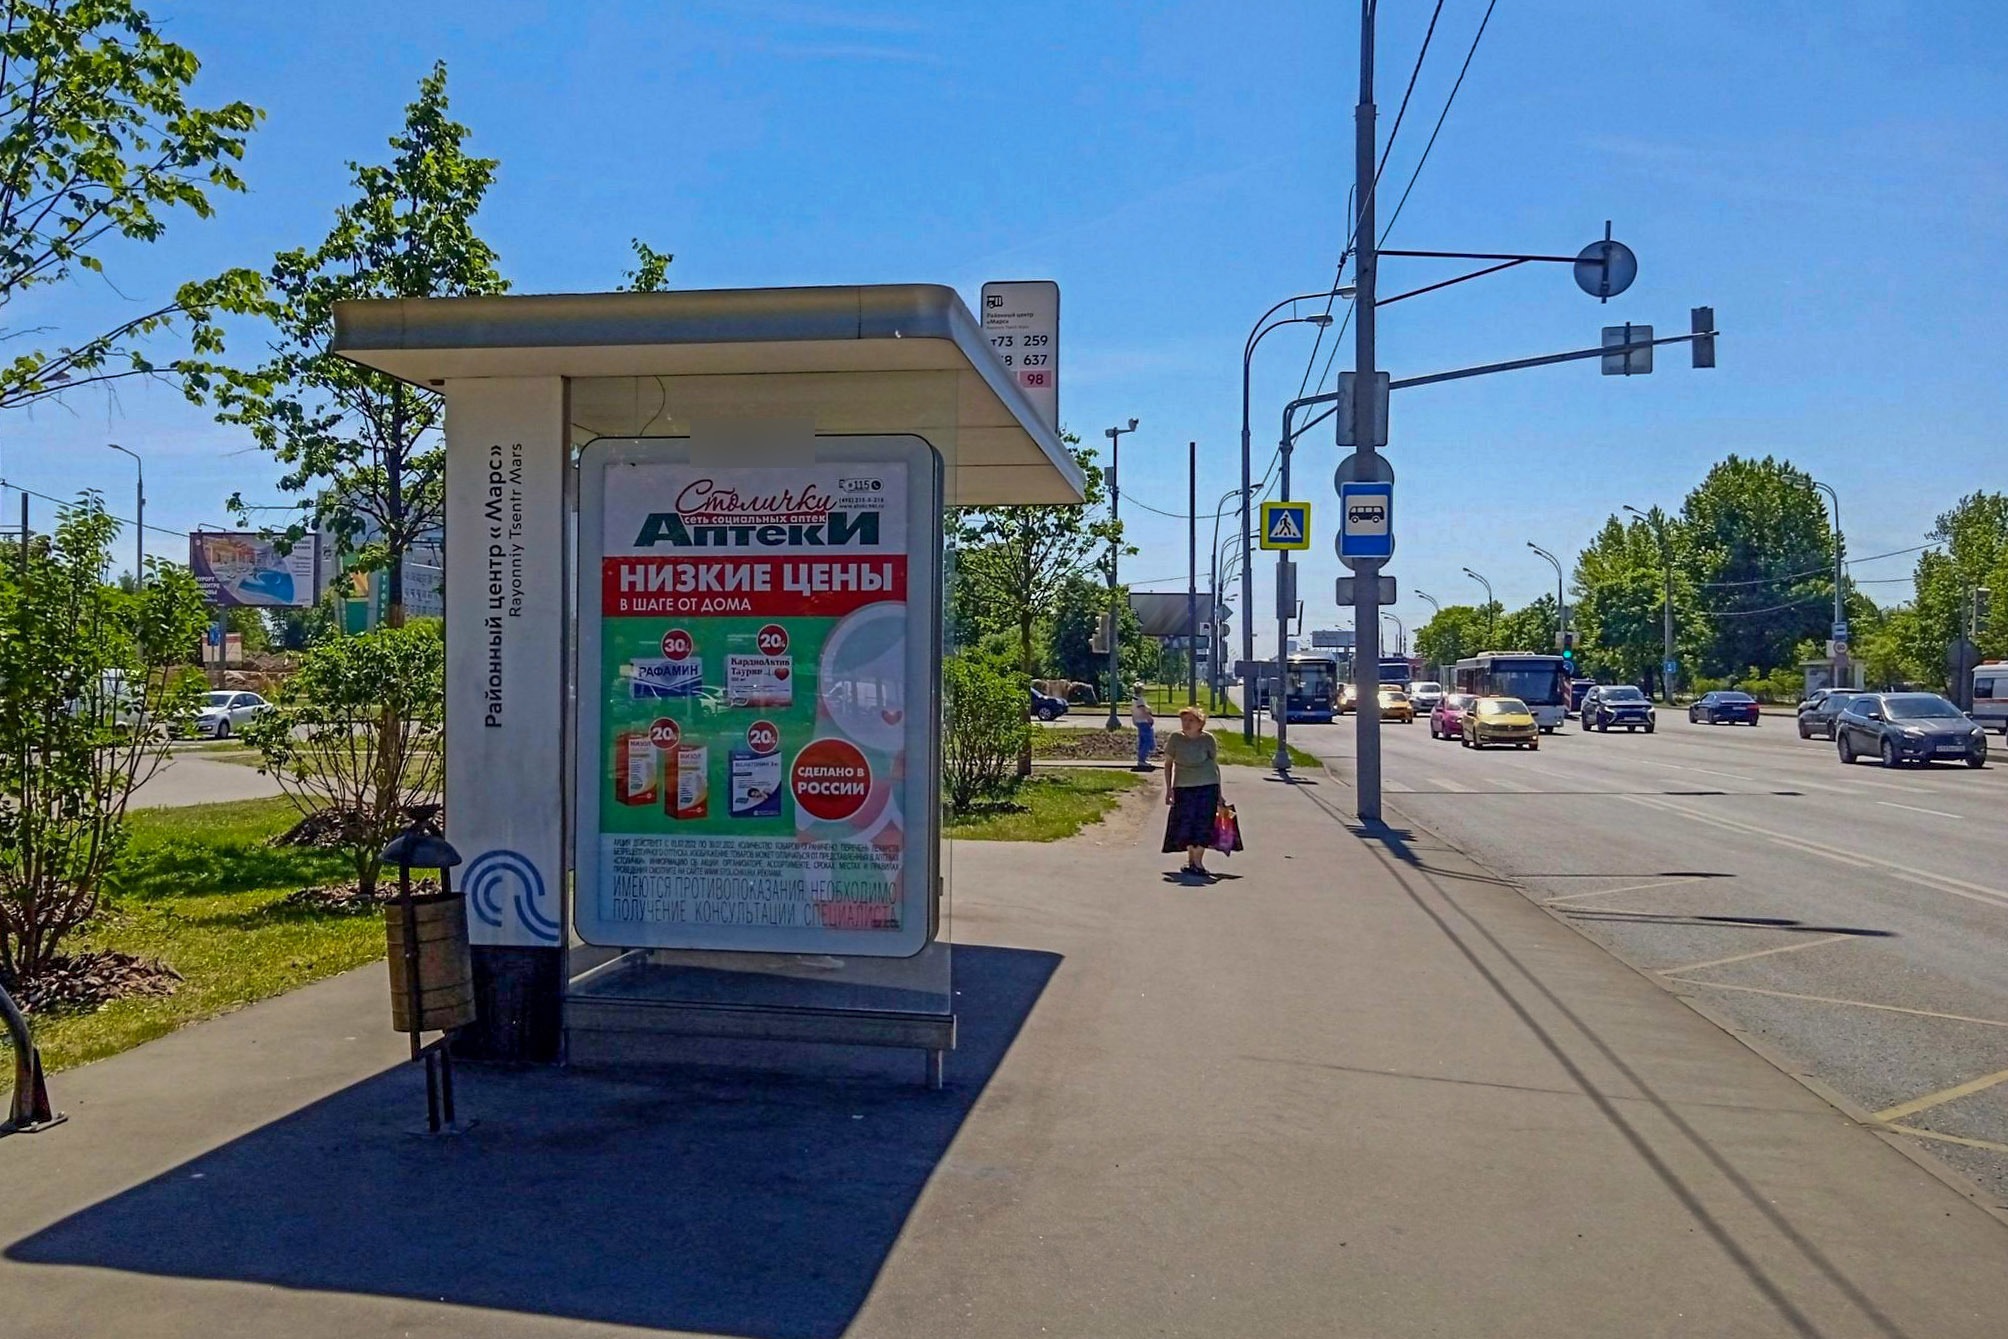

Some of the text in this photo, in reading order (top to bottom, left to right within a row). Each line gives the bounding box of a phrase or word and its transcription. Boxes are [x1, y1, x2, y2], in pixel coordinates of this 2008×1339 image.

[1023, 335, 1049, 346] 259
[1023, 354, 1048, 366] 637
[1027, 374, 1044, 385] 98
[675, 478, 838, 514] Столички
[684, 514, 826, 525] сеть социальных аптек
[508, 443, 525, 617] Rayonniy Tsentr Mars
[488, 544, 506, 610] центр
[620, 563, 893, 597] НИЗКИЕ ЦЕНЫ
[619, 598, 752, 613] В ШАГЕ ОТ ДОМА
[484, 617, 503, 728] Районный
[797, 766, 865, 778] СДЕЛАНО В
[797, 782, 865, 796] РОССИИ
[613, 875, 671, 897] ИМЕЮТСЯ
[811, 880, 897, 905] НЕОБХОДИМО
[613, 898, 686, 922] ПОЛУЧЕНИЕ
[695, 901, 795, 924] КОНСУЛЬТАЦИИ
